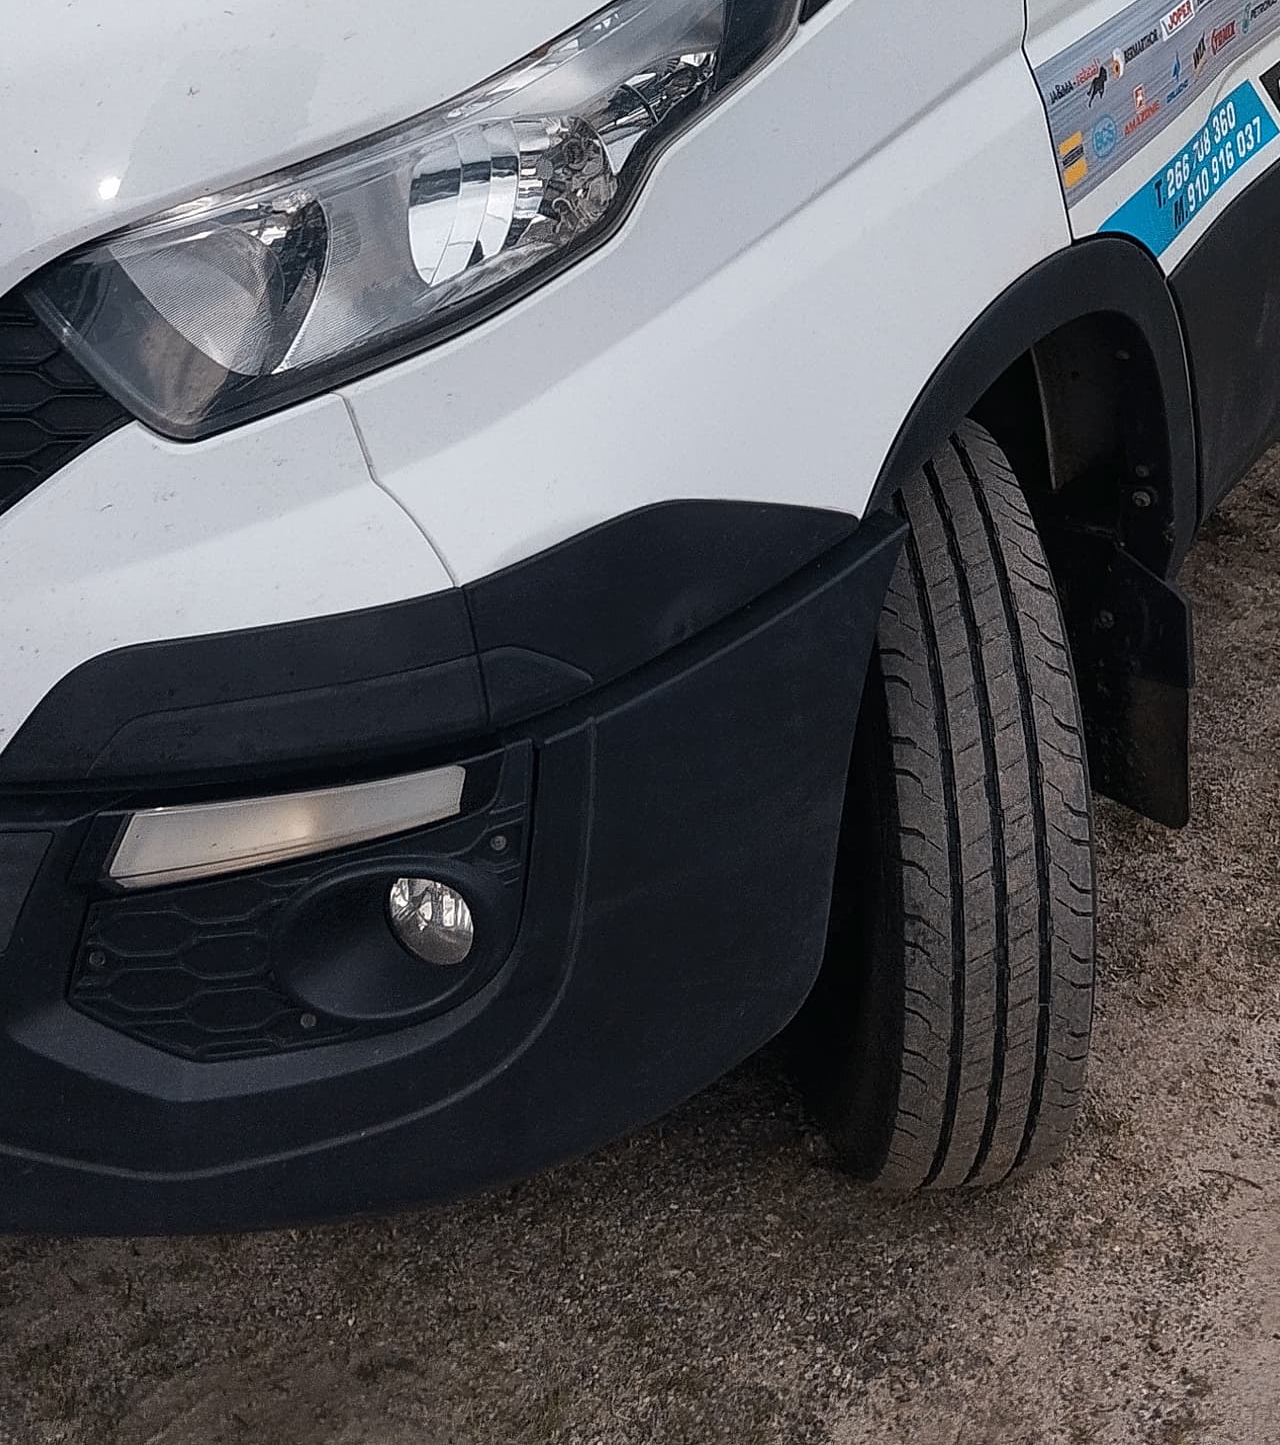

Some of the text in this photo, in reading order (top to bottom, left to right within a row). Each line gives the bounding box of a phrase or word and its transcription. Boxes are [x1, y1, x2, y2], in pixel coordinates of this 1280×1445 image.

[1212, 101, 1236, 144] 360
[1211, 141, 1235, 186] 916
[1236, 116, 1261, 158] 037
